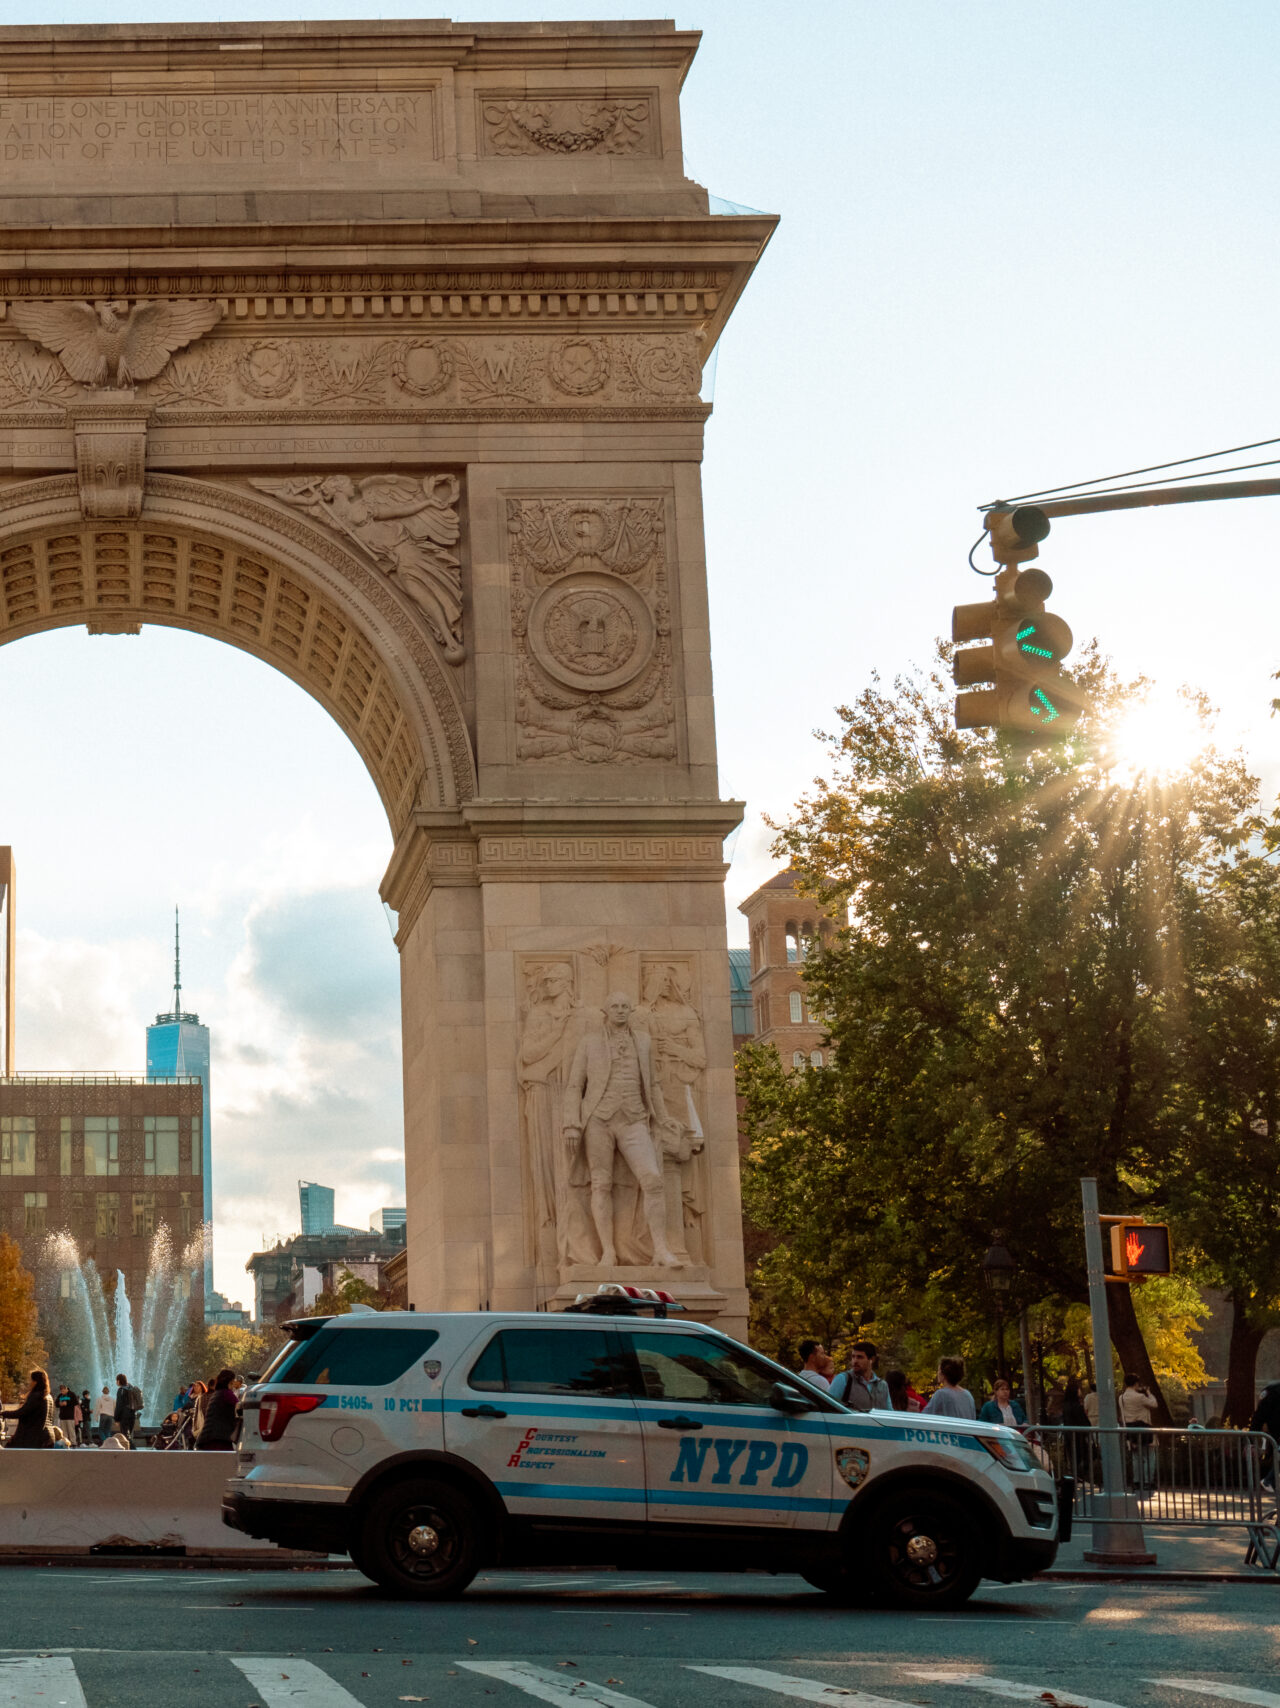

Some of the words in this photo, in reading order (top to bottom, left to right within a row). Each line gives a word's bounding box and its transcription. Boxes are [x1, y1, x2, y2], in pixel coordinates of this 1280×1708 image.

[22, 102, 66, 119] THE
[71, 101, 118, 118] ONE
[124, 98, 260, 118] HUNDREDTH
[268, 96, 421, 115] ANNIVERSARY
[95, 121, 128, 138] OF
[136, 120, 233, 137] GEORGE
[245, 117, 418, 136] WASHINGTON
[81, 142, 114, 159] OF
[128, 141, 178, 158] THE
[192, 140, 285, 157] UNITED
[7, 443, 72, 455] PEOPLE
[151, 443, 170, 453] OF
[180, 442, 210, 453] THE
[216, 441, 259, 452] CITY
[266, 440, 288, 452] OF
[293, 440, 331, 451] NEW
[342, 439, 387, 450] YORK
[384, 1398, 396, 1411] 10
[399, 1398, 420, 1412] PCT
[525, 1428, 579, 1443] COURTESY
[906, 1428, 960, 1447] POLICE
[515, 1441, 606, 1458] PROFESSIONALISM
[507, 1454, 555, 1469] RESPECT
[669, 1437, 808, 1488] NYPD
